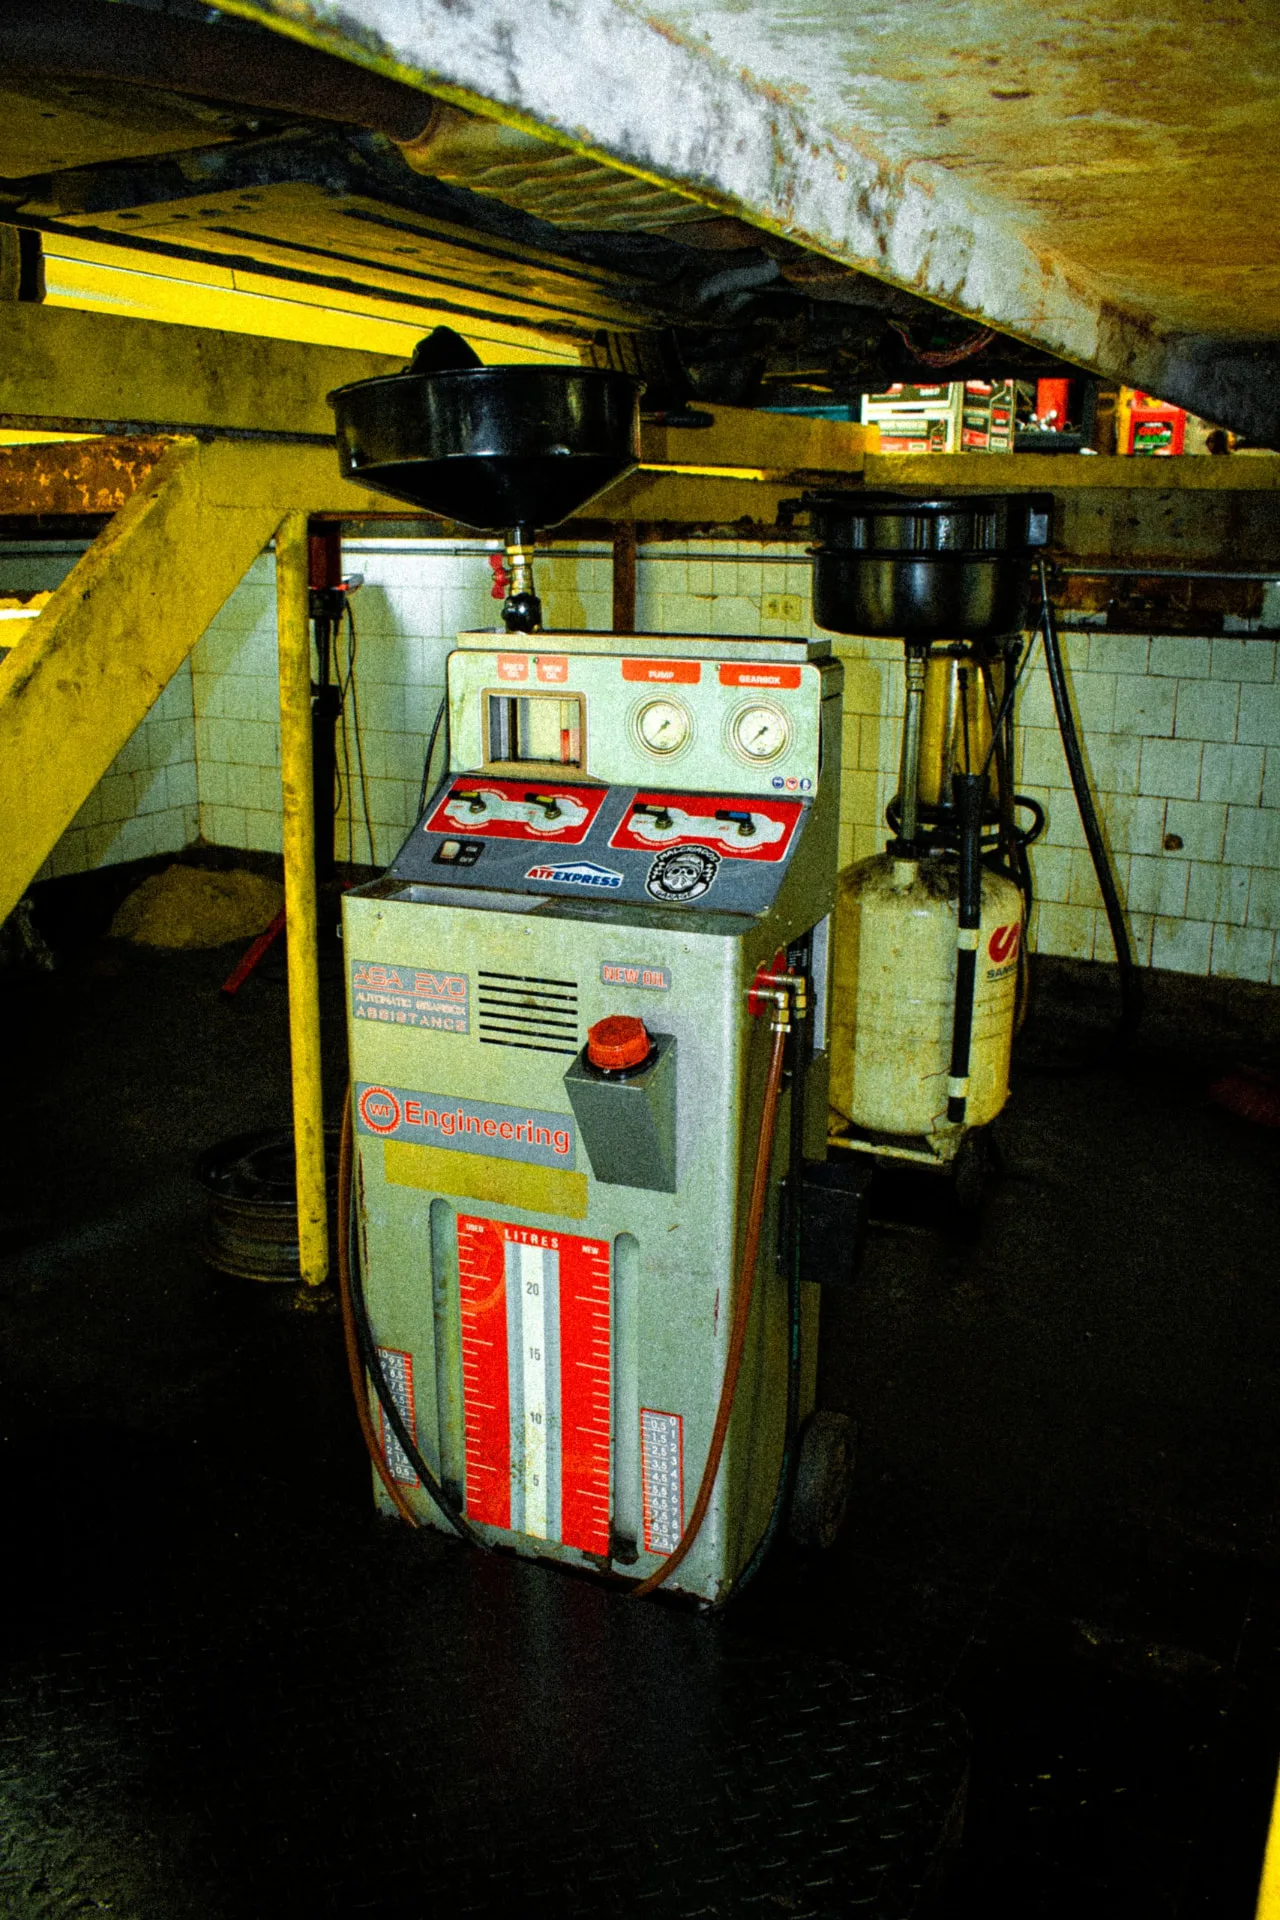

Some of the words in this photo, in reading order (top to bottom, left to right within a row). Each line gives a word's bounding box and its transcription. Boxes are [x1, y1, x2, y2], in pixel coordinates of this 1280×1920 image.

[648, 670, 675, 680] PUMP
[738, 675, 781, 685] GEARBOX
[354, 966, 403, 988] AGA
[414, 972, 466, 997] EVO
[603, 965, 640, 985] NEW
[642, 969, 668, 988] OIL
[356, 1005, 467, 1032] ASSISTANCE
[368, 1102, 393, 1118] WT
[403, 1099, 571, 1156] Engineering
[465, 1222, 485, 1233] USED
[504, 1228, 560, 1248] LITRES
[581, 1244, 599, 1255] NEW
[526, 1281, 540, 1296] 20
[529, 1347, 541, 1361] 15
[530, 1411, 542, 1425] 10
[669, 1416, 677, 1426] 0
[651, 1420, 667, 1431] 0.5
[652, 1432, 667, 1444] 1.5
[671, 1429, 676, 1439] 1
[651, 1445, 667, 1457] 2.5
[670, 1443, 677, 1453] 2
[651, 1459, 667, 1471] 3.5
[670, 1456, 677, 1466] 3
[651, 1472, 667, 1483] 4.5
[670, 1469, 677, 1479] 4
[532, 1473, 540, 1487] 5
[671, 1482, 678, 1492] 5
[671, 1495, 678, 1504] 6
[671, 1507, 678, 1517] 7
[672, 1519, 678, 1529] 8
[671, 1532, 678, 1542] 9
